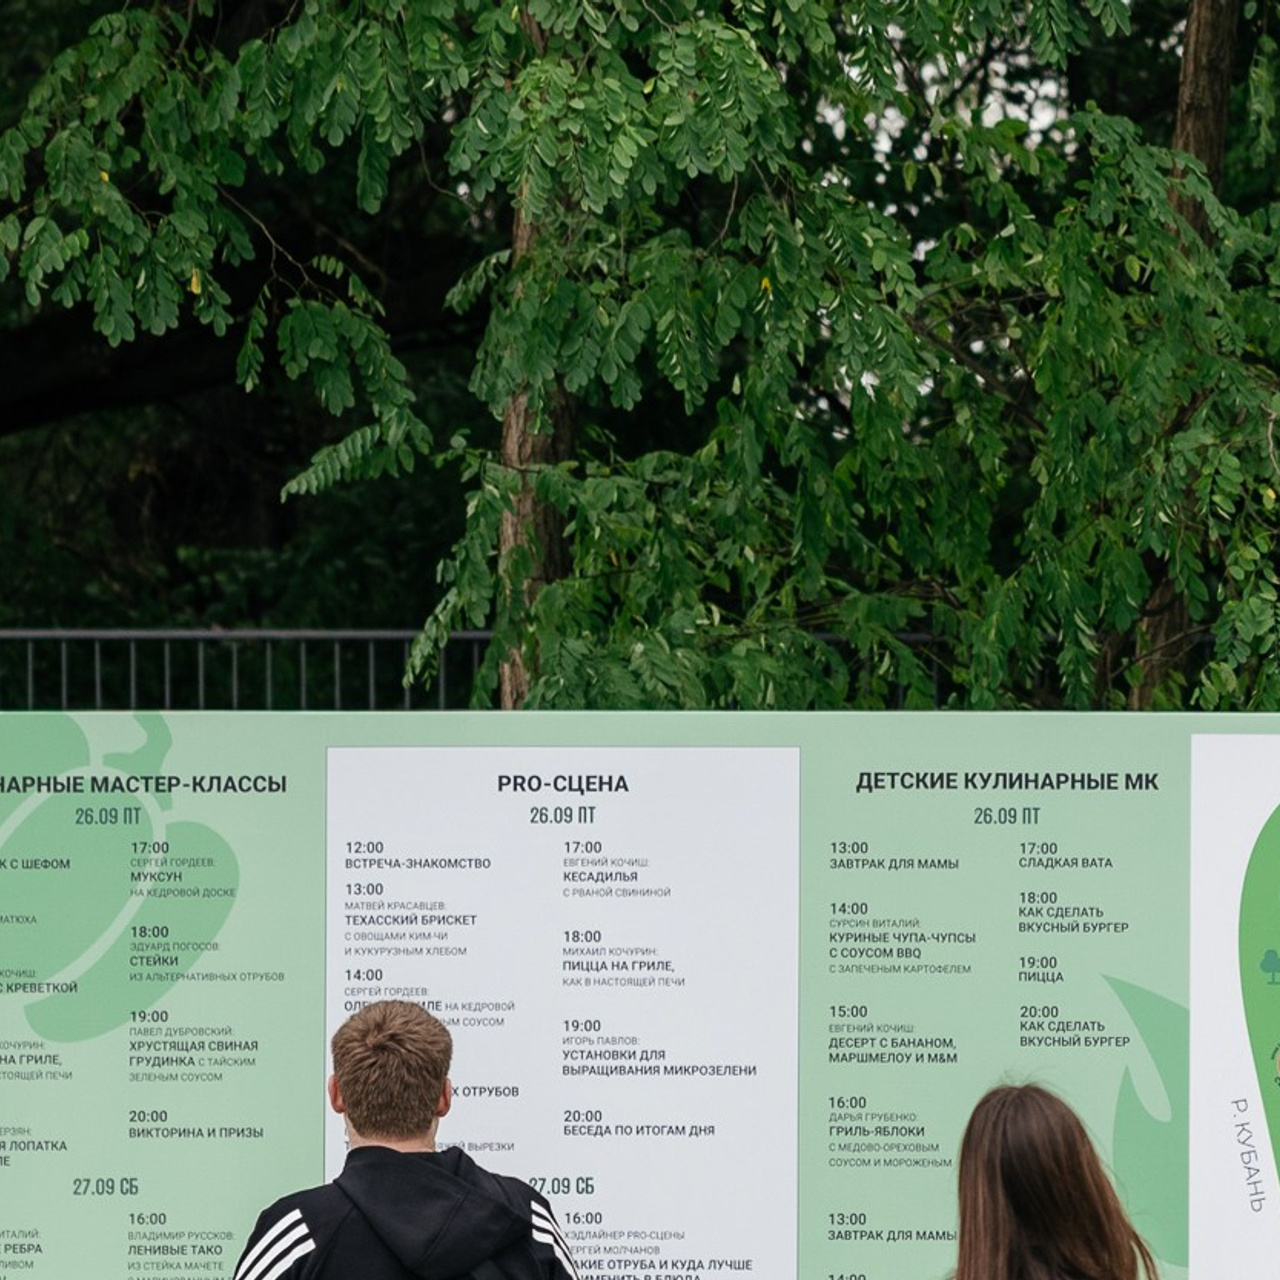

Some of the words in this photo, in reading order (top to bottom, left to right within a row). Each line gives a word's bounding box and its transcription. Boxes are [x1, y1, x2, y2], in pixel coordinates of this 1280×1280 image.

[91, 776, 286, 793] МАСТЕР-КЛАССЫ
[498, 775, 629, 796] PRO-СЦЕНА
[856, 772, 958, 793] ДЕТСКИЕ
[964, 773, 1119, 790] КУЛИНАРНЫЕ
[1125, 773, 1159, 790] МК
[75, 807, 118, 825] 26.09
[123, 807, 141, 824] ПТ
[132, 842, 169, 854] 17:00
[346, 841, 384, 854] 12:00
[831, 842, 868, 854] 13:00
[345, 858, 491, 869] ВСТРЕЧА-ЗНАКОМСТВО
[830, 858, 885, 869] ЗАВТРАК
[888, 858, 914, 871] ДЛЯ
[917, 859, 959, 869] МАМЫ
[1019, 857, 1078, 870] СЛАДКАЯ
[1082, 858, 1113, 868] ВАТА
[131, 871, 182, 882] МУКСУН
[564, 871, 638, 884] КЕСАДИЛЬЯ
[345, 913, 418, 925] ТЕХАССКИЙ
[421, 915, 477, 925] БРИСКЕТ
[1019, 920, 1079, 933] ВКУСНЫЙ
[1083, 922, 1129, 933] БУРГЕР
[830, 932, 889, 943] КУРИНЫЕ
[893, 932, 976, 943] ЧУПА-ЧУПСЫ
[563, 961, 608, 973] ПИЦЦА
[611, 961, 629, 971] НА
[632, 961, 674, 973] ГРИЛЕ,
[1019, 971, 1064, 983] ПИЦЦА
[130, 1041, 205, 1054] ХРУСТЯЩАЯ
[208, 1040, 258, 1051] СВИНАЯ
[562, 1065, 660, 1077] ВЫРАЩИВАНИЯ
[664, 1065, 757, 1076] МИКРОЗЕЛЕНИ
[564, 1125, 612, 1137] БЕСЕДА
[615, 1125, 633, 1136] ПО
[636, 1125, 686, 1136] ИТОГАМ
[689, 1125, 715, 1137] ДНЯ
[829, 1126, 924, 1137] ГРИЛЬ-ЯБЛОКИ
[73, 1178, 115, 1195] 27.09
[120, 1178, 138, 1196] СБ
[128, 1245, 187, 1255] ЛЕНИВЫЕ
[191, 1245, 223, 1255] ТАКО
